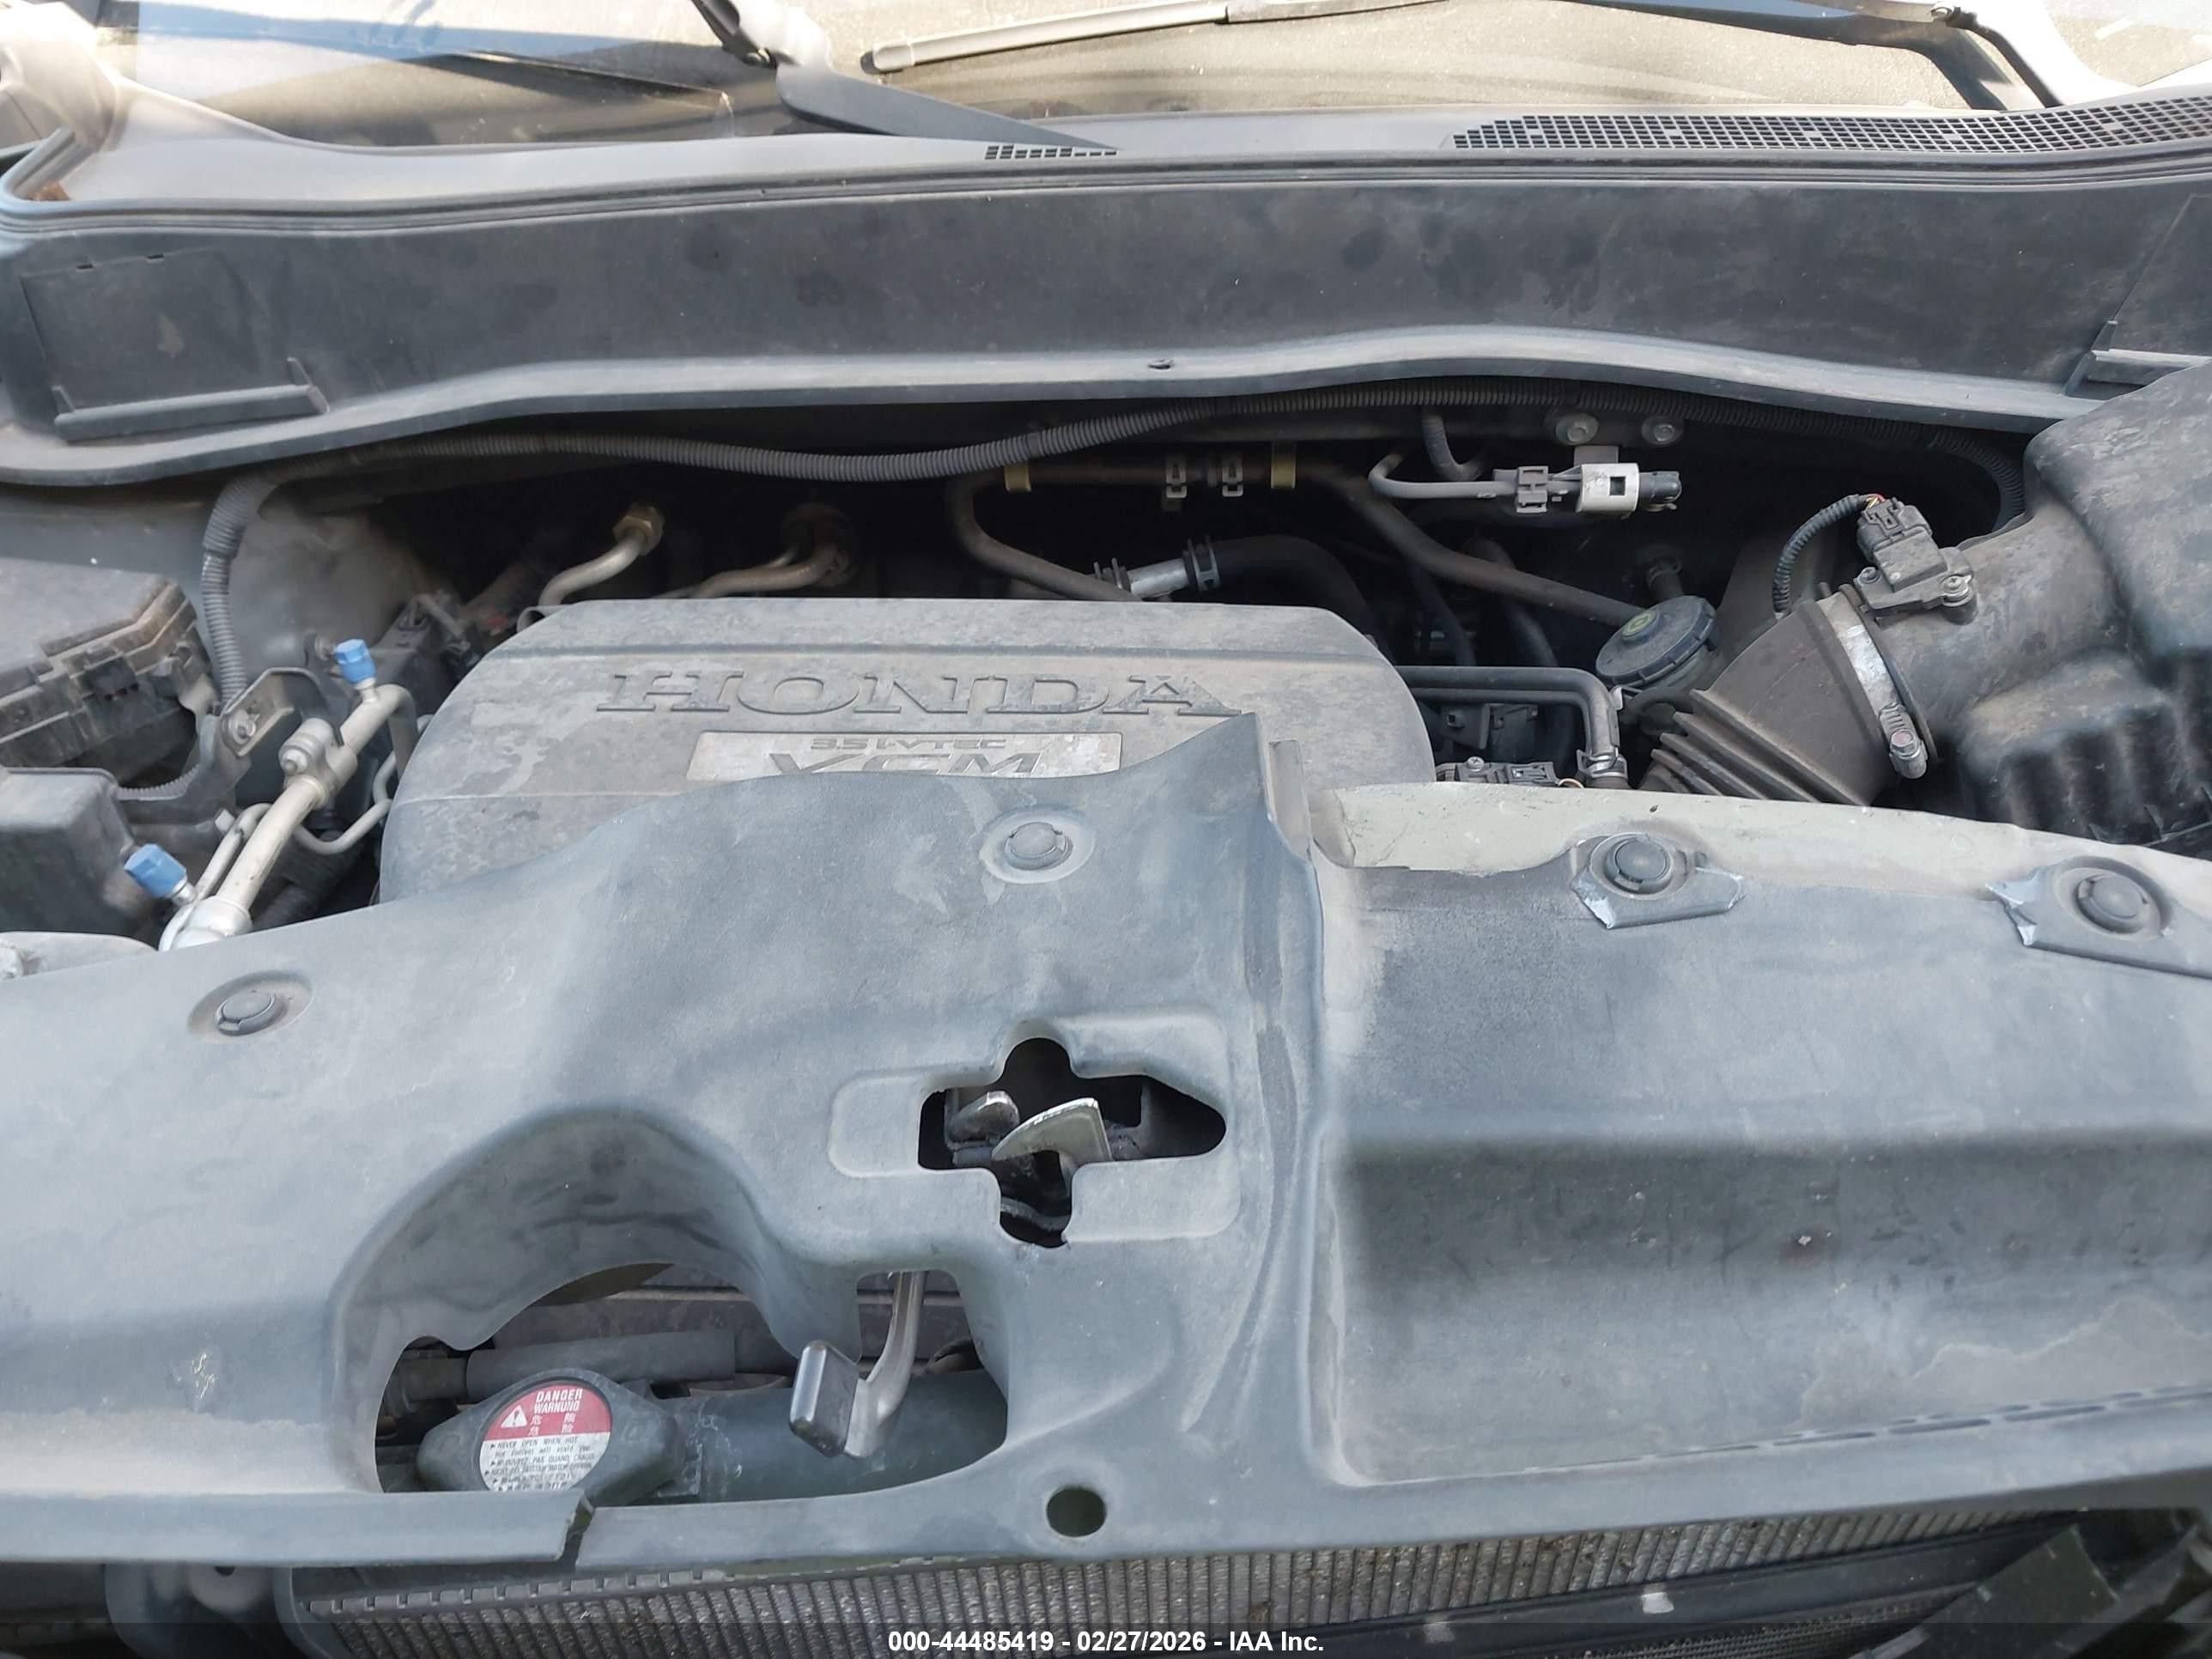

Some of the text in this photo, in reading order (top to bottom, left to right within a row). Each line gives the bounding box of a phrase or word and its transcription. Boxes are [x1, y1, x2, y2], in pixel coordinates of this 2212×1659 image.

[594, 670, 1242, 716] HONDA
[810, 738, 869, 750] 3.5
[769, 753, 1042, 775] VCM
[536, 1389, 584, 1402] DANGER
[533, 1401, 580, 1413] WARNUNG
[497, 1441, 517, 1449] NEVER
